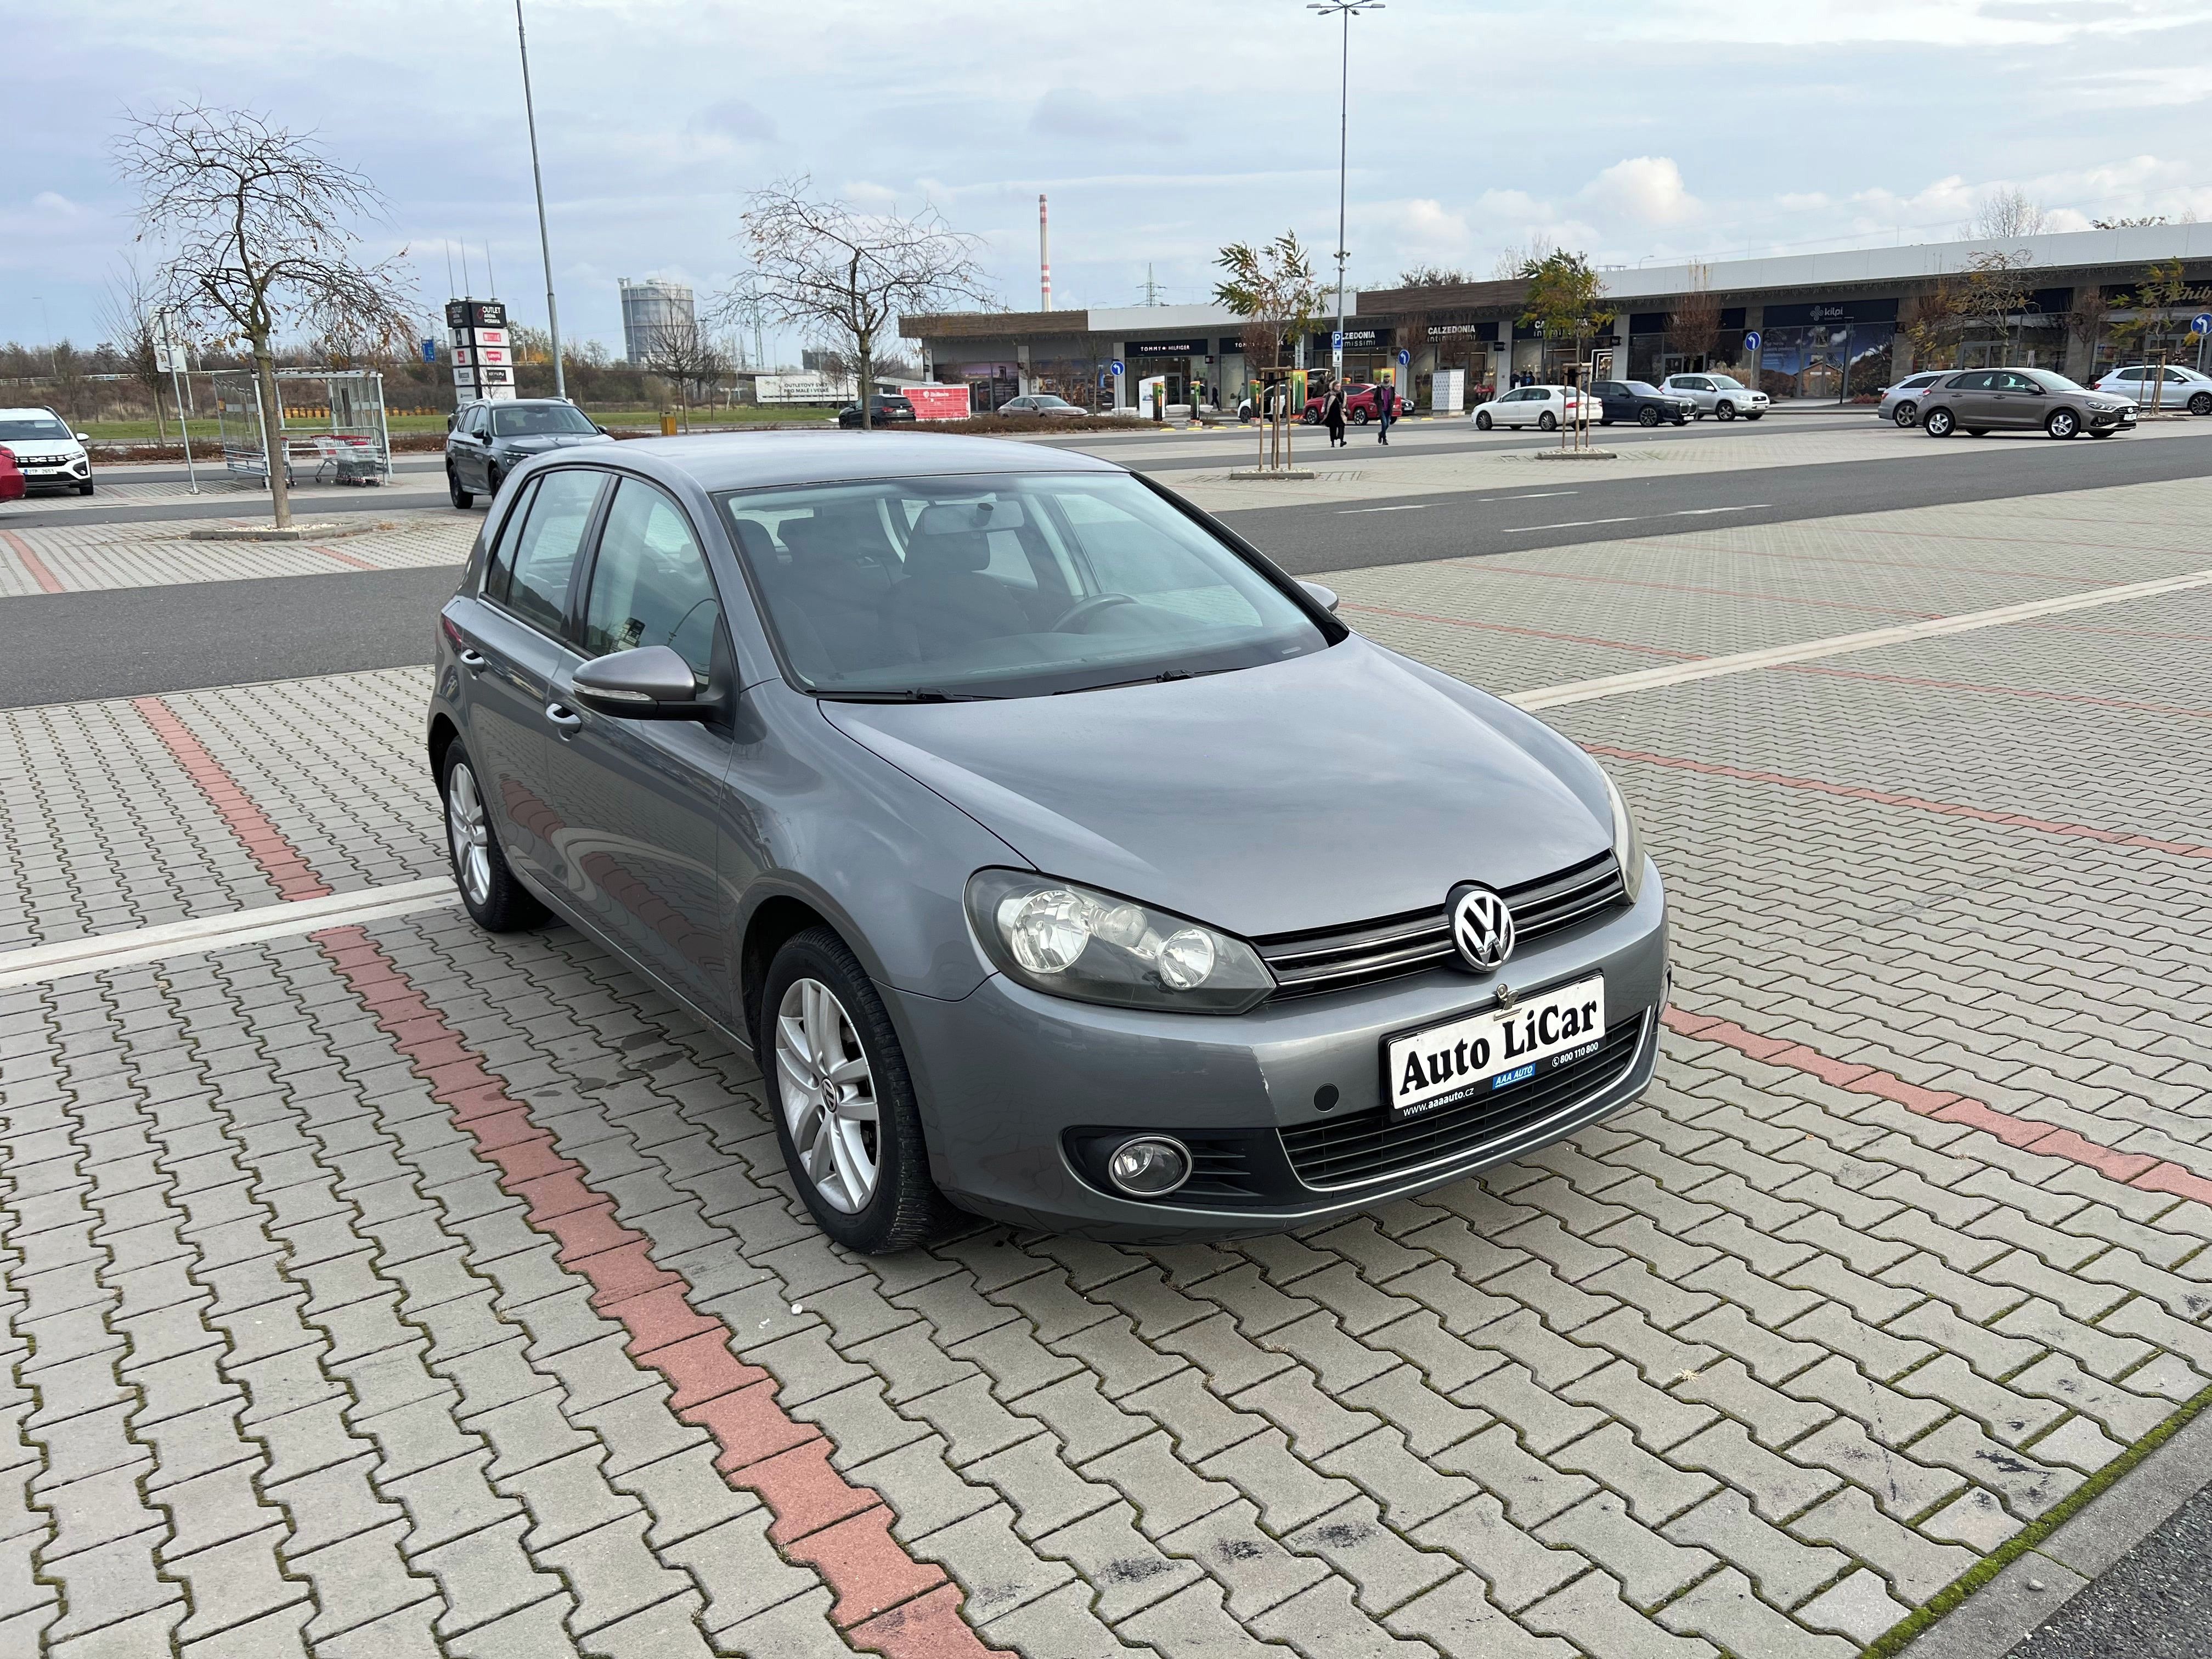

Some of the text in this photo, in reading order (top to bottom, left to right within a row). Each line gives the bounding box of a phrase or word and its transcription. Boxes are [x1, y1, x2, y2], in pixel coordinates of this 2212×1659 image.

[482, 306, 501, 314] OUTLET
[1824, 307, 1843, 317] kilpi
[1331, 331, 1375, 340] ZEDONIA
[1427, 325, 1476, 335] CALZEDONIA
[1334, 334, 1341, 345] P
[1400, 1000, 1597, 1096] Auto LiCar
[1560, 1041, 1599, 1064] 800 110 800
[1495, 1065, 1533, 1086] AAA AUTO
[1403, 1087, 1475, 1116] www.aaaauto.cz
